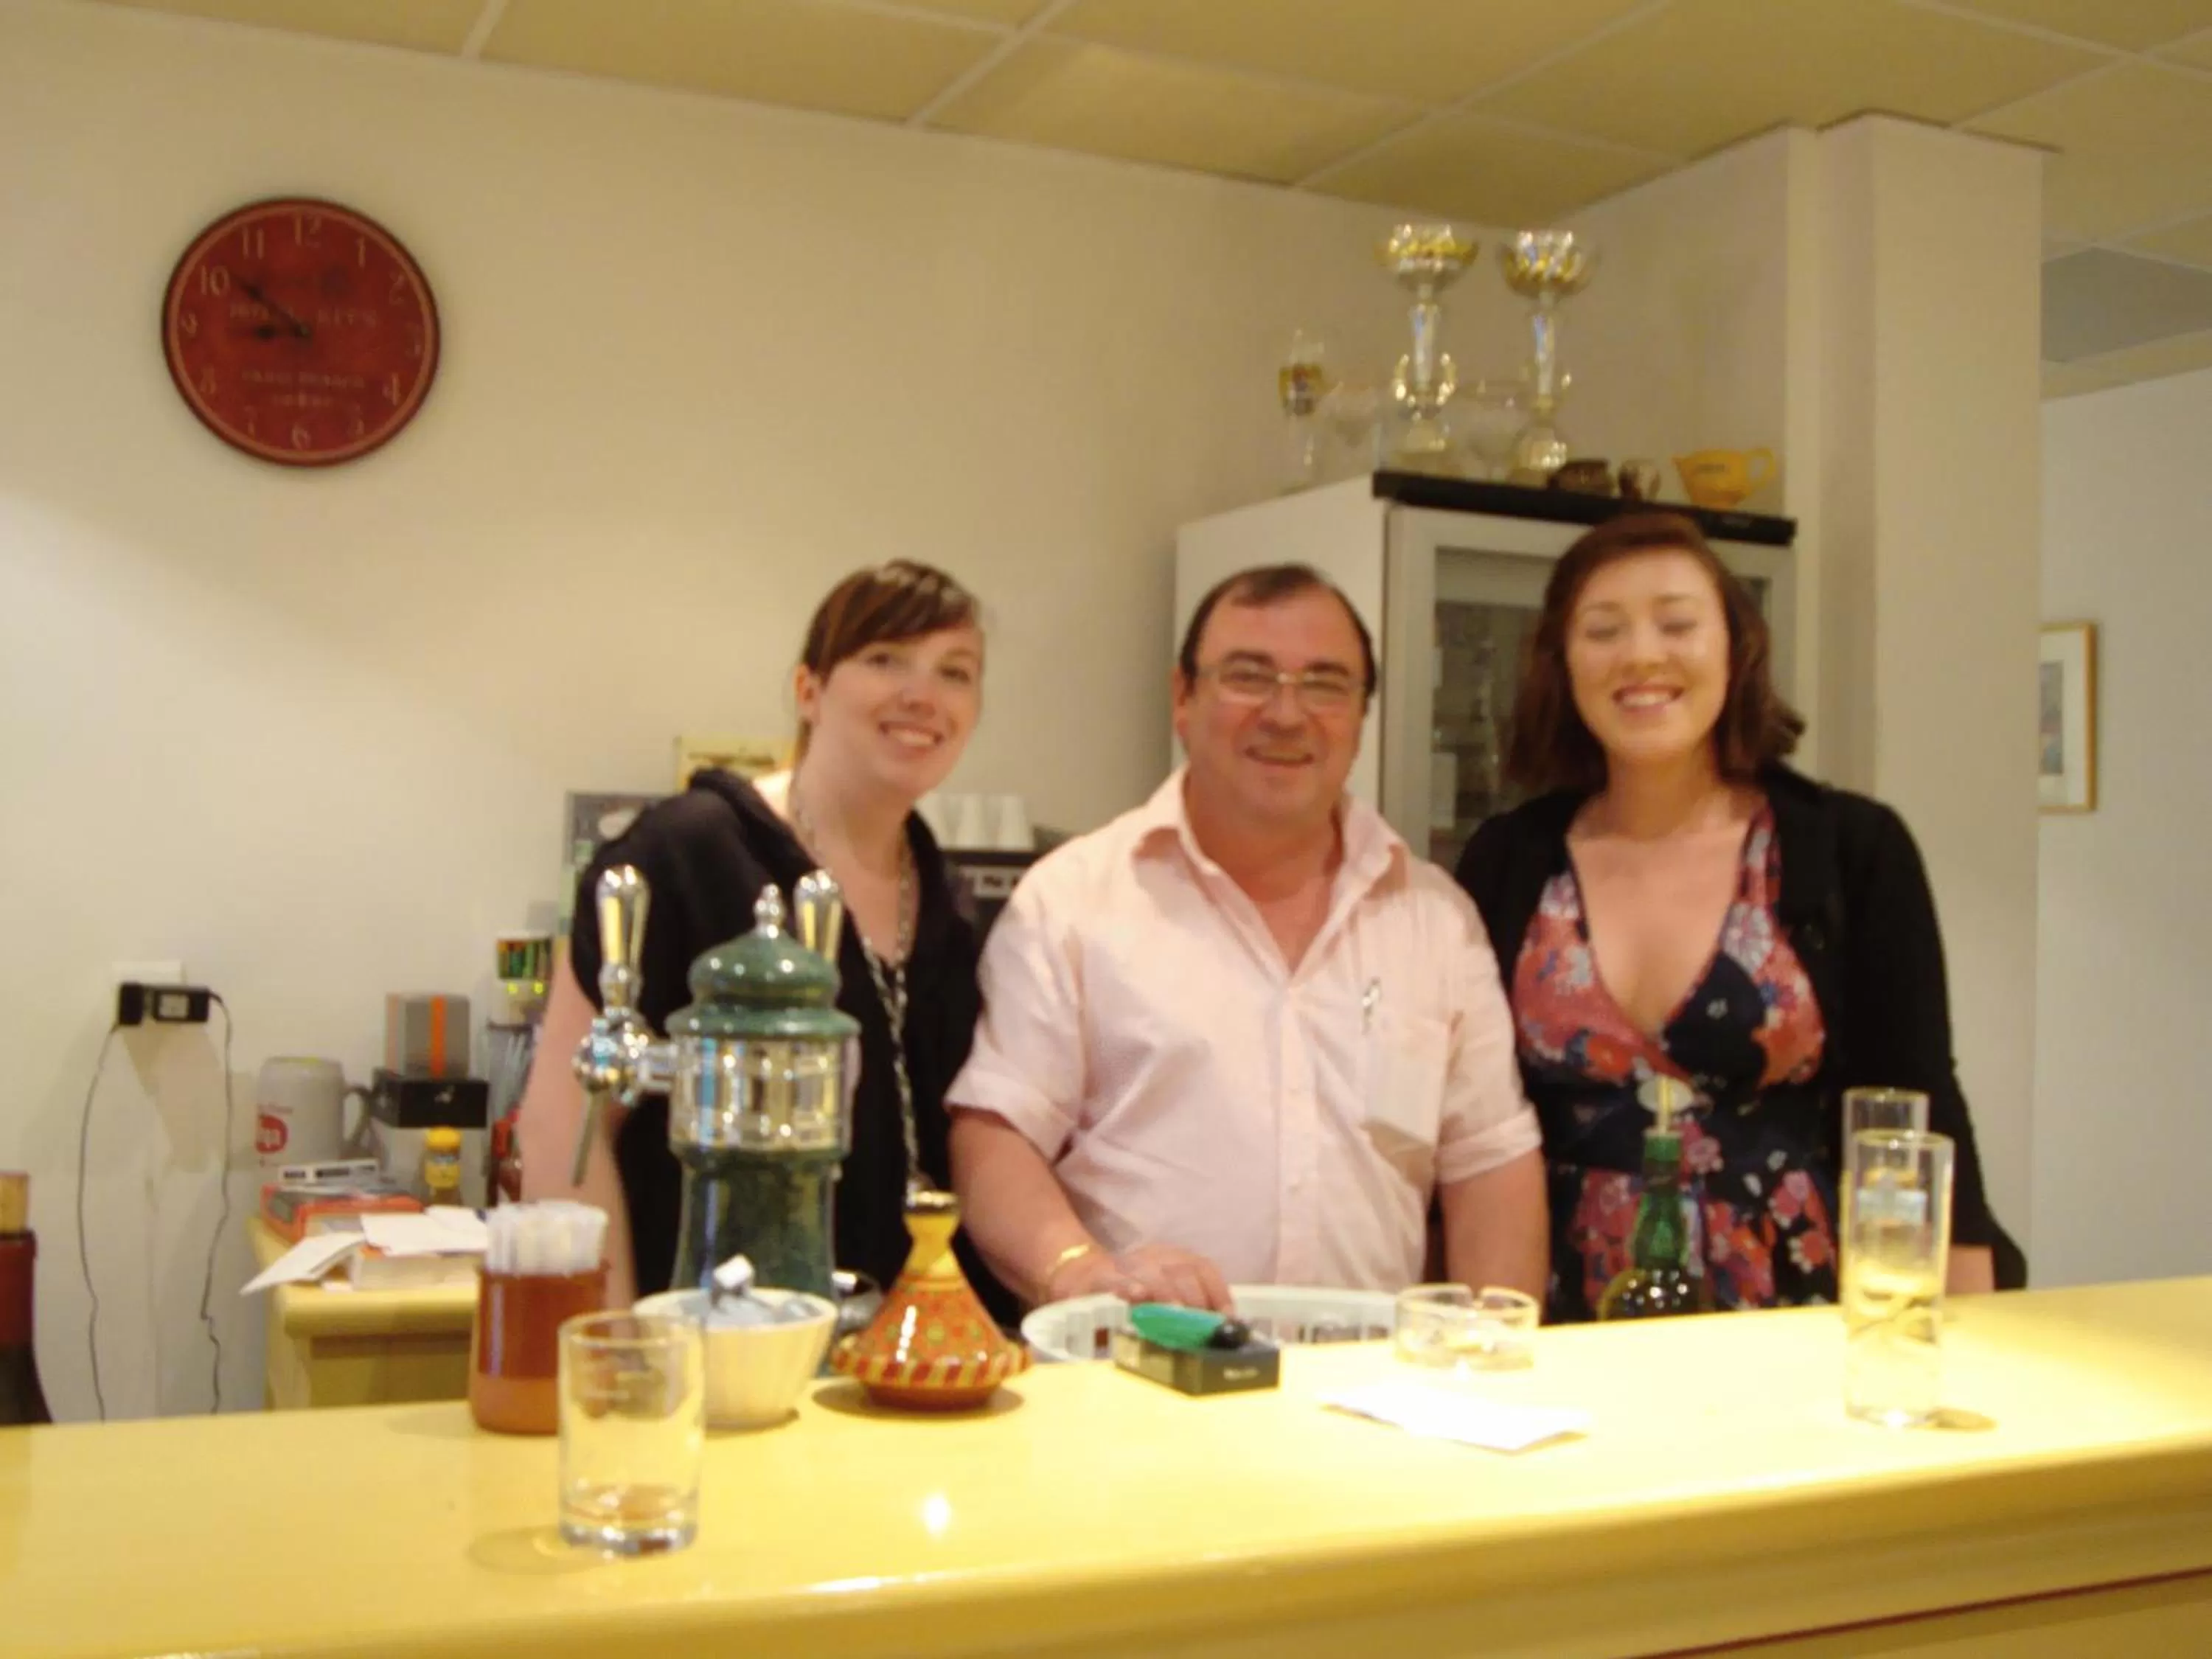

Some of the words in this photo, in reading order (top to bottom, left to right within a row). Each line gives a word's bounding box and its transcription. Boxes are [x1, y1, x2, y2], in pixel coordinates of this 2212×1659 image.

[241, 227, 265, 260] 11
[293, 212, 322, 248] 12
[355, 236, 366, 268] 1
[200, 265, 231, 297] 10
[291, 422, 312, 451] 6
